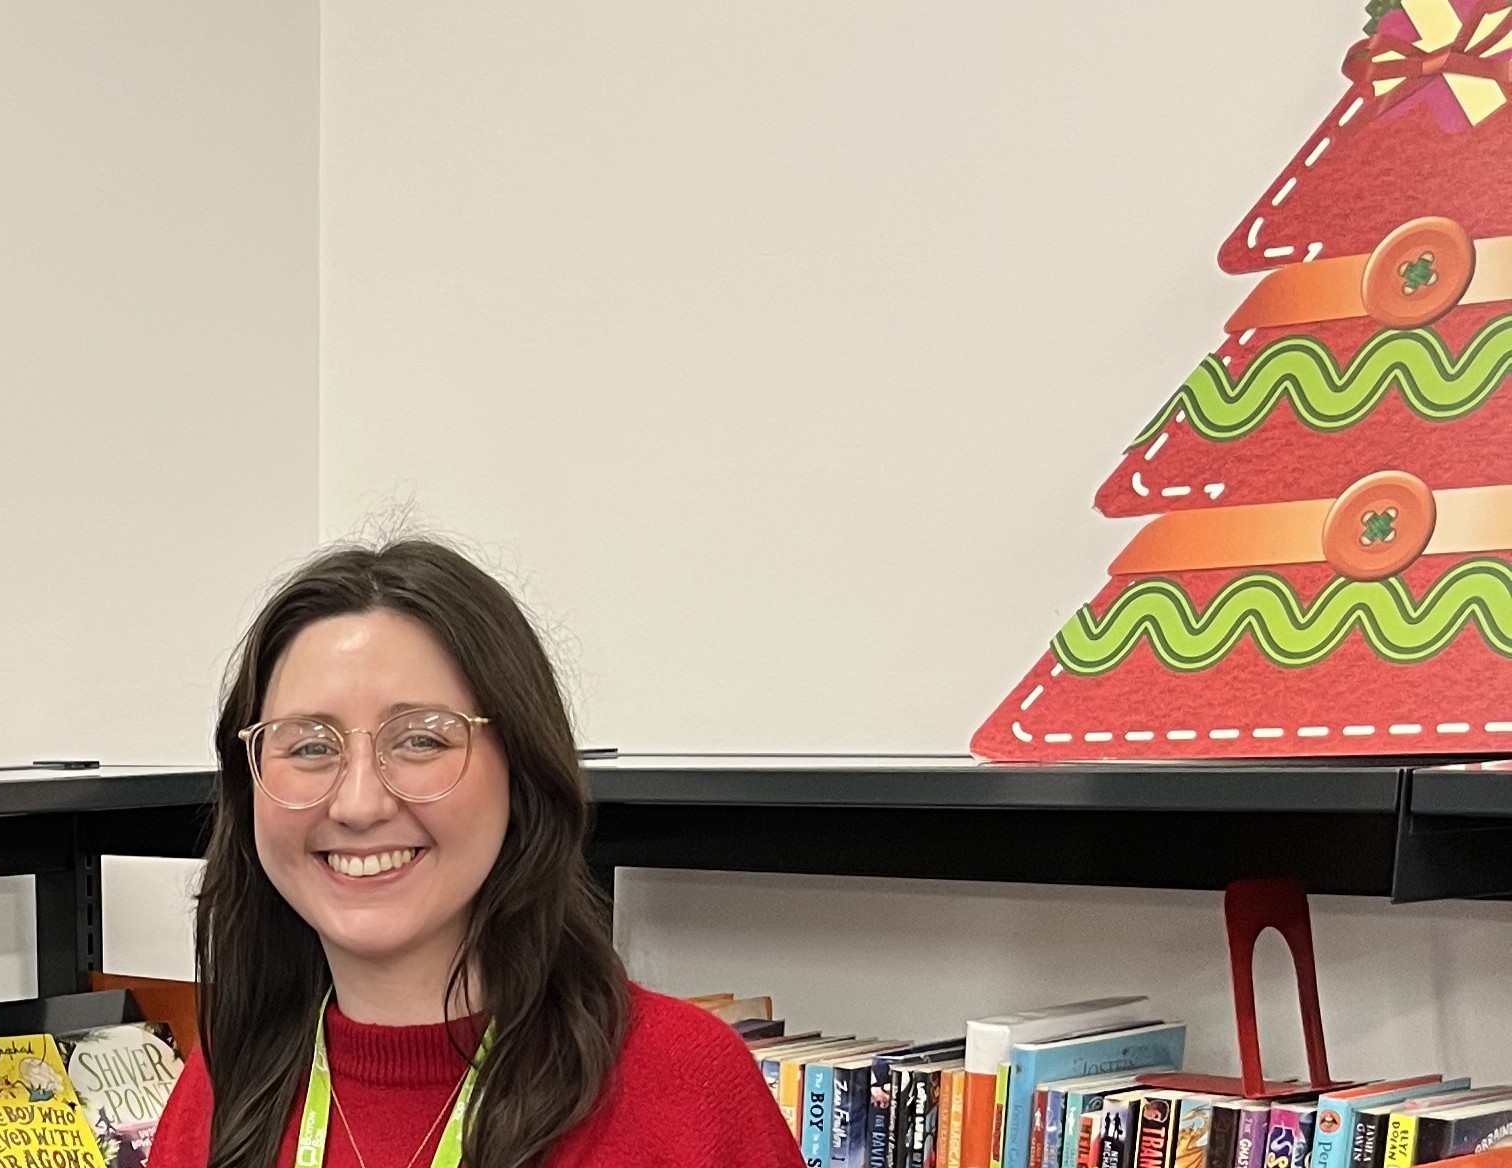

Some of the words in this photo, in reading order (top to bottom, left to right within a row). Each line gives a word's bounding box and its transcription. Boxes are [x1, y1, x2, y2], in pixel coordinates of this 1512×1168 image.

[5, 1105, 35, 1126] BOY
[37, 1106, 76, 1126] WHO
[809, 1091, 825, 1131] BOY
[32, 1130, 83, 1148] WITH
[1080, 1124, 1092, 1158] NEIL
[1352, 1123, 1365, 1161] GAVIN
